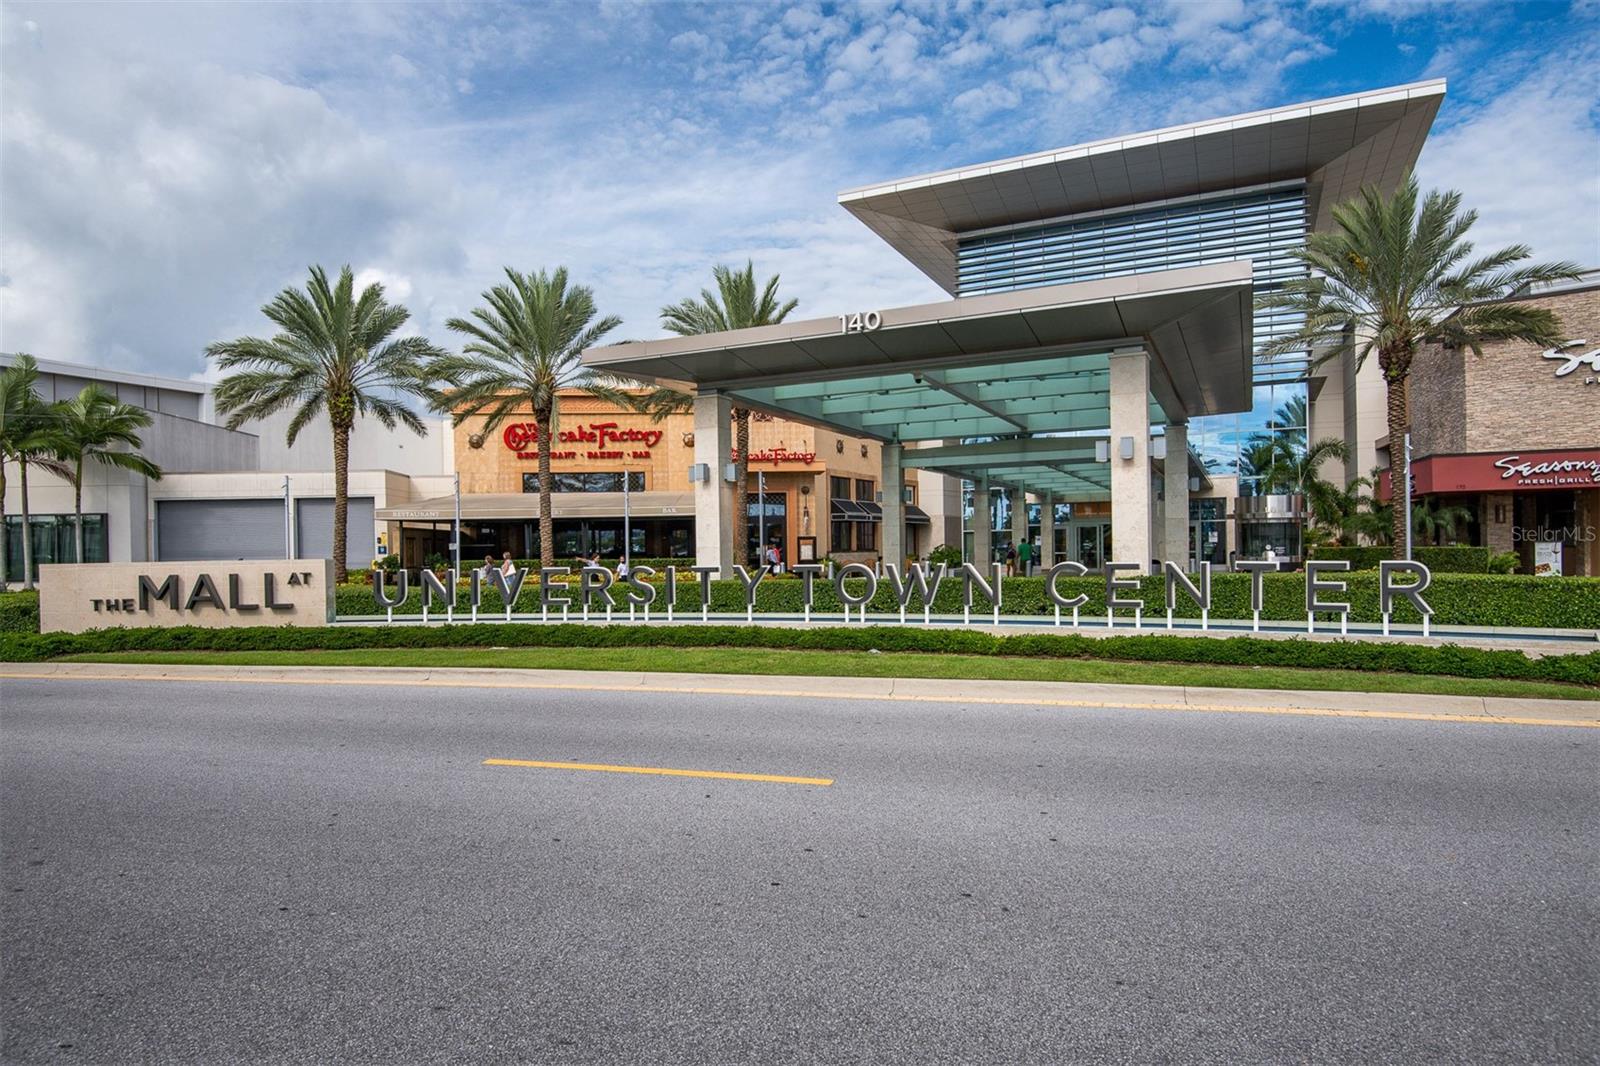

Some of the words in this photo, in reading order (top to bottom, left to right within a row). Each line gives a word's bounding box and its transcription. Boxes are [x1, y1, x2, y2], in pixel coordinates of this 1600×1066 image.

[839, 311, 881, 333] 140
[589, 422, 662, 449] Factory
[632, 451, 651, 459] BAR
[768, 448, 816, 466] Factory
[1495, 456, 1597, 478] Seasons
[90, 599, 135, 612] THE
[138, 573, 294, 611] MALL
[287, 572, 312, 585] AT
[373, 565, 769, 607] UNIVERSITY
[793, 562, 1002, 607] TOWN
[1044, 560, 1435, 615] CENTER
